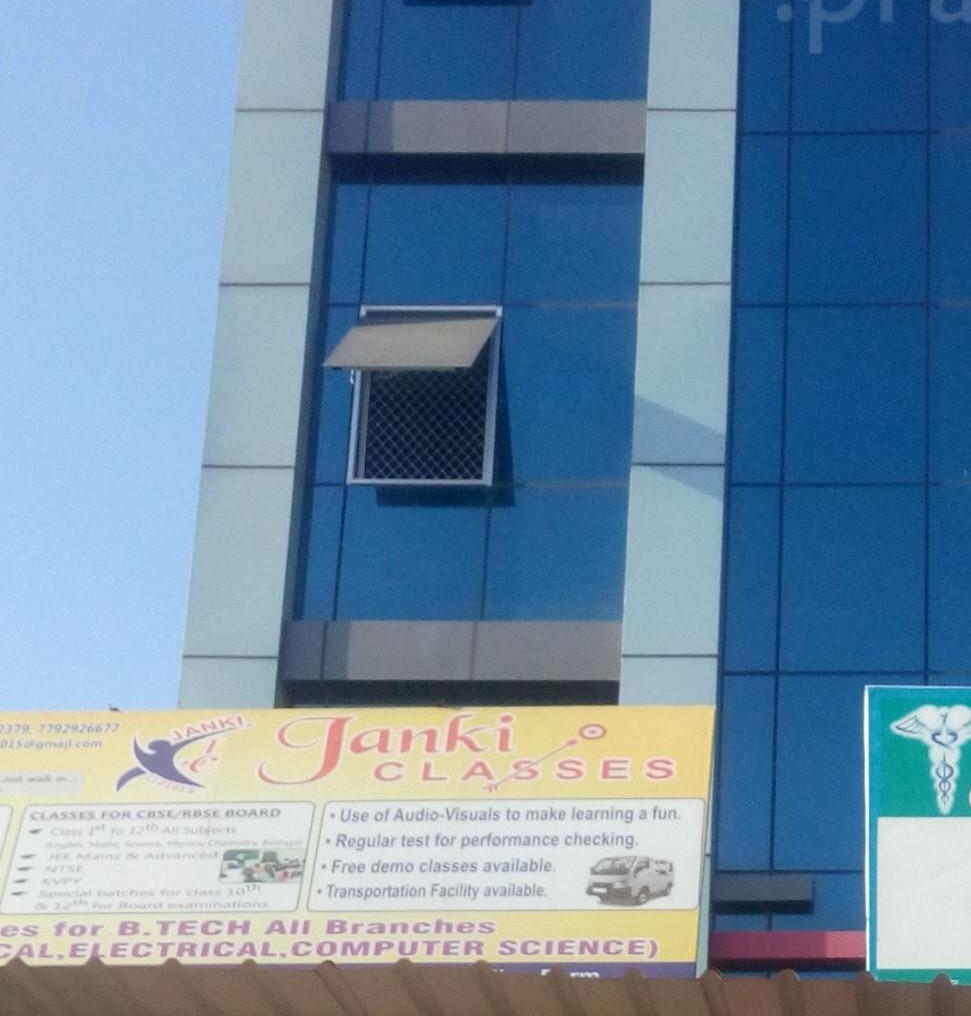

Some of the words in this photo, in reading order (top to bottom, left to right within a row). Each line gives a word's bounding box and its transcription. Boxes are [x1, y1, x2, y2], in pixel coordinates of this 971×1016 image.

[172, 714, 244, 741] JANKI
[258, 714, 516, 784] Janki
[374, 760, 674, 781] CLASSES
[30, 810, 95, 820] CLASSES
[101, 810, 131, 820] FOR
[137, 809, 220, 820] CBSE/RBSE
[226, 808, 281, 818] BOARD
[340, 808, 369, 822] Use
[374, 808, 389, 822] of
[394, 807, 500, 822] Audio-Visuals
[506, 808, 520, 821] to
[525, 807, 566, 821] make
[572, 807, 633, 823] learning
[639, 810, 647, 820] a
[653, 806, 681, 820] fun.
[336, 834, 395, 851] Regular
[401, 834, 429, 847] test
[435, 834, 456, 847] for
[460, 834, 559, 849] performance
[564, 832, 638, 849] checking.
[331, 859, 365, 873] Free
[371, 859, 414, 873] demo
[419, 859, 477, 872] classes
[483, 858, 556, 872] available.
[327, 884, 426, 900] Transportation
[430, 883, 479, 900] Facility
[484, 883, 547, 898] available.
[54, 920, 104, 937] for
[119, 920, 250, 936] B.TECH
[264, 920, 311, 935] All
[326, 919, 496, 935] Branches
[499, 939, 658, 958] SCIENCE)
